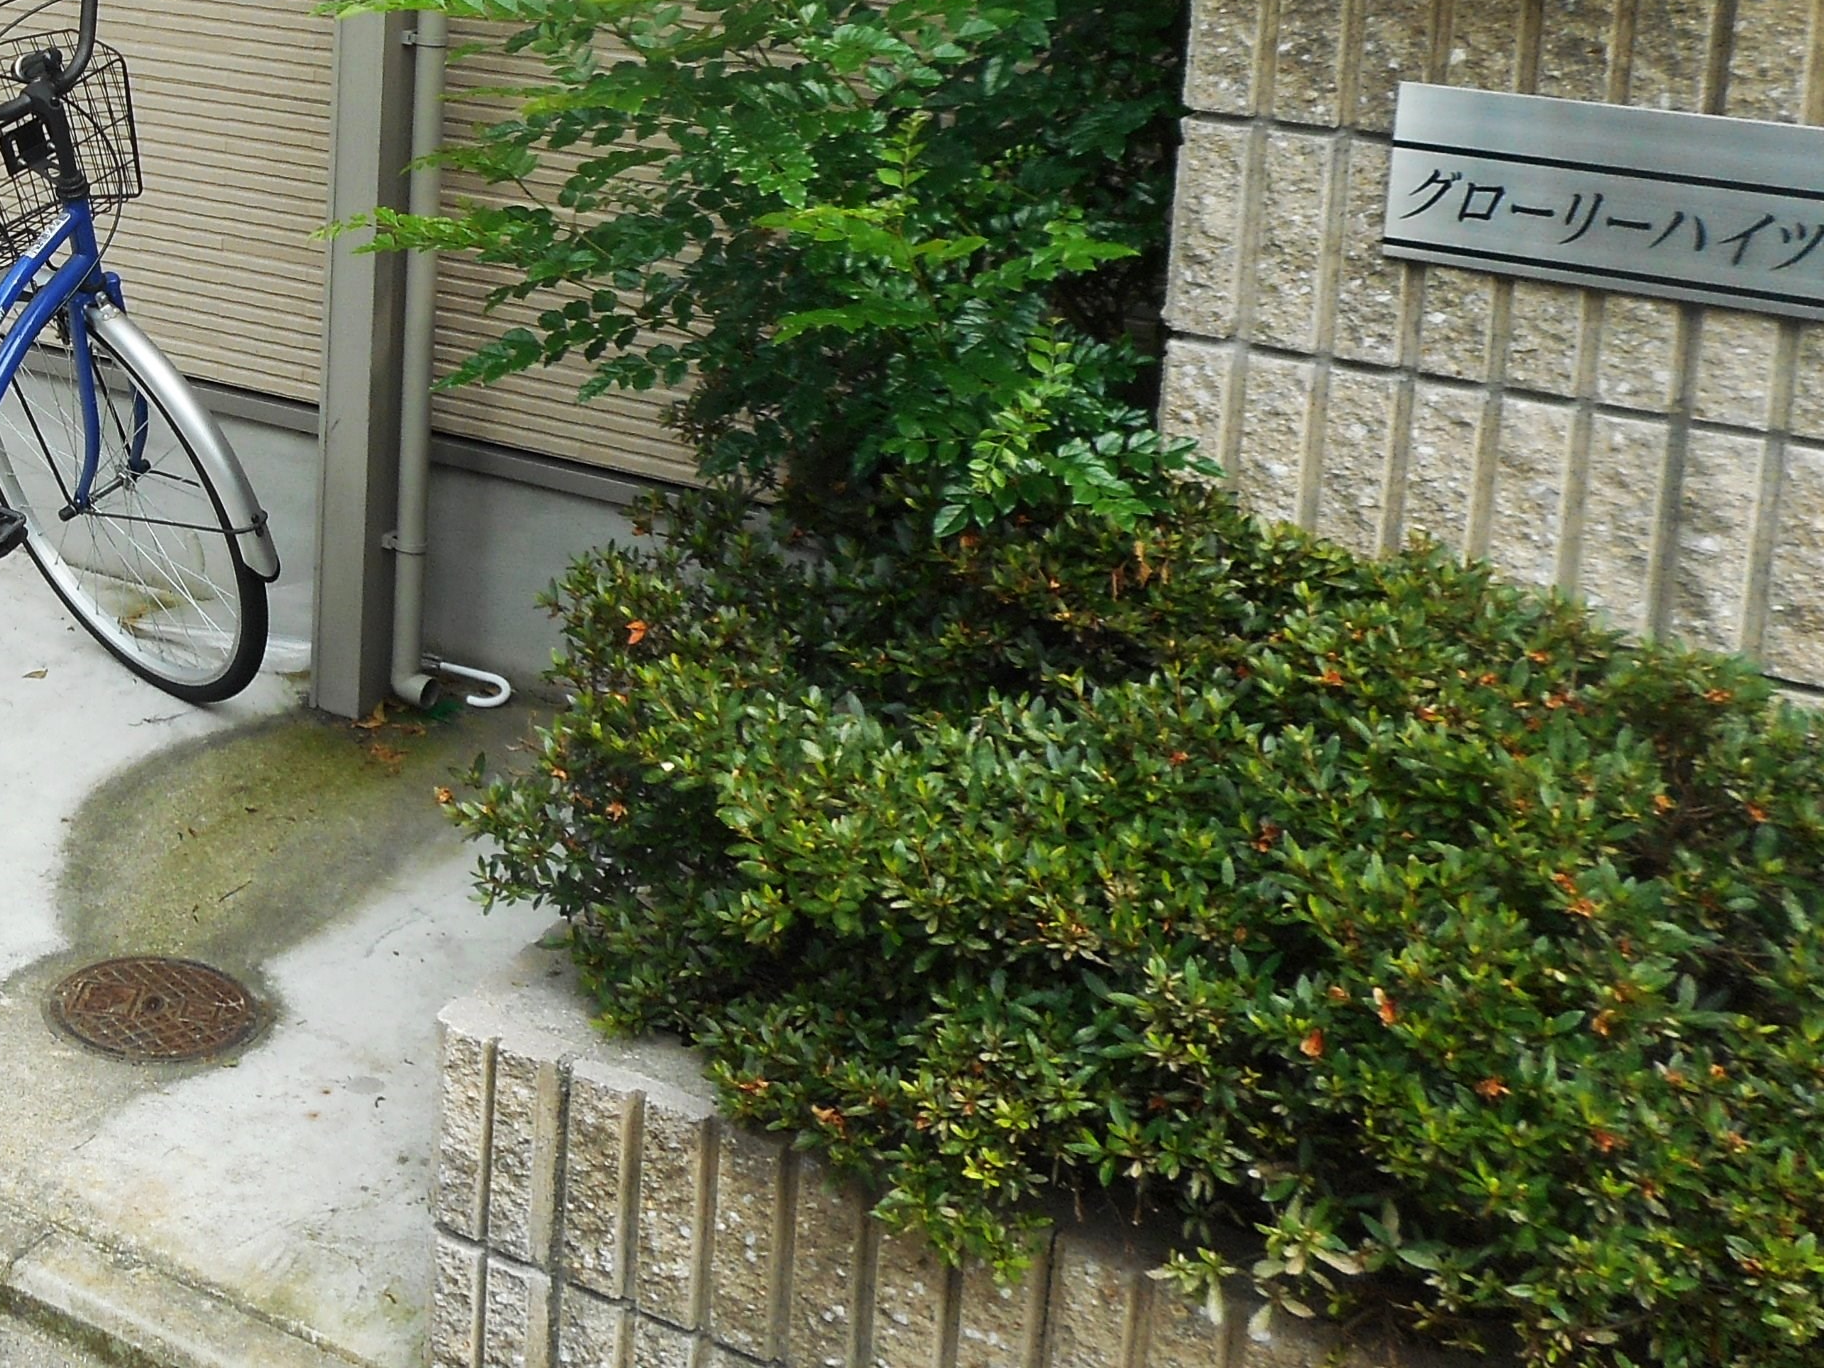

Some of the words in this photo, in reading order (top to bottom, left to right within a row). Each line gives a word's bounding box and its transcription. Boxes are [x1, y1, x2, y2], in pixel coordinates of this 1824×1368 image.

[1399, 169, 1824, 270] グローリーハイツ
